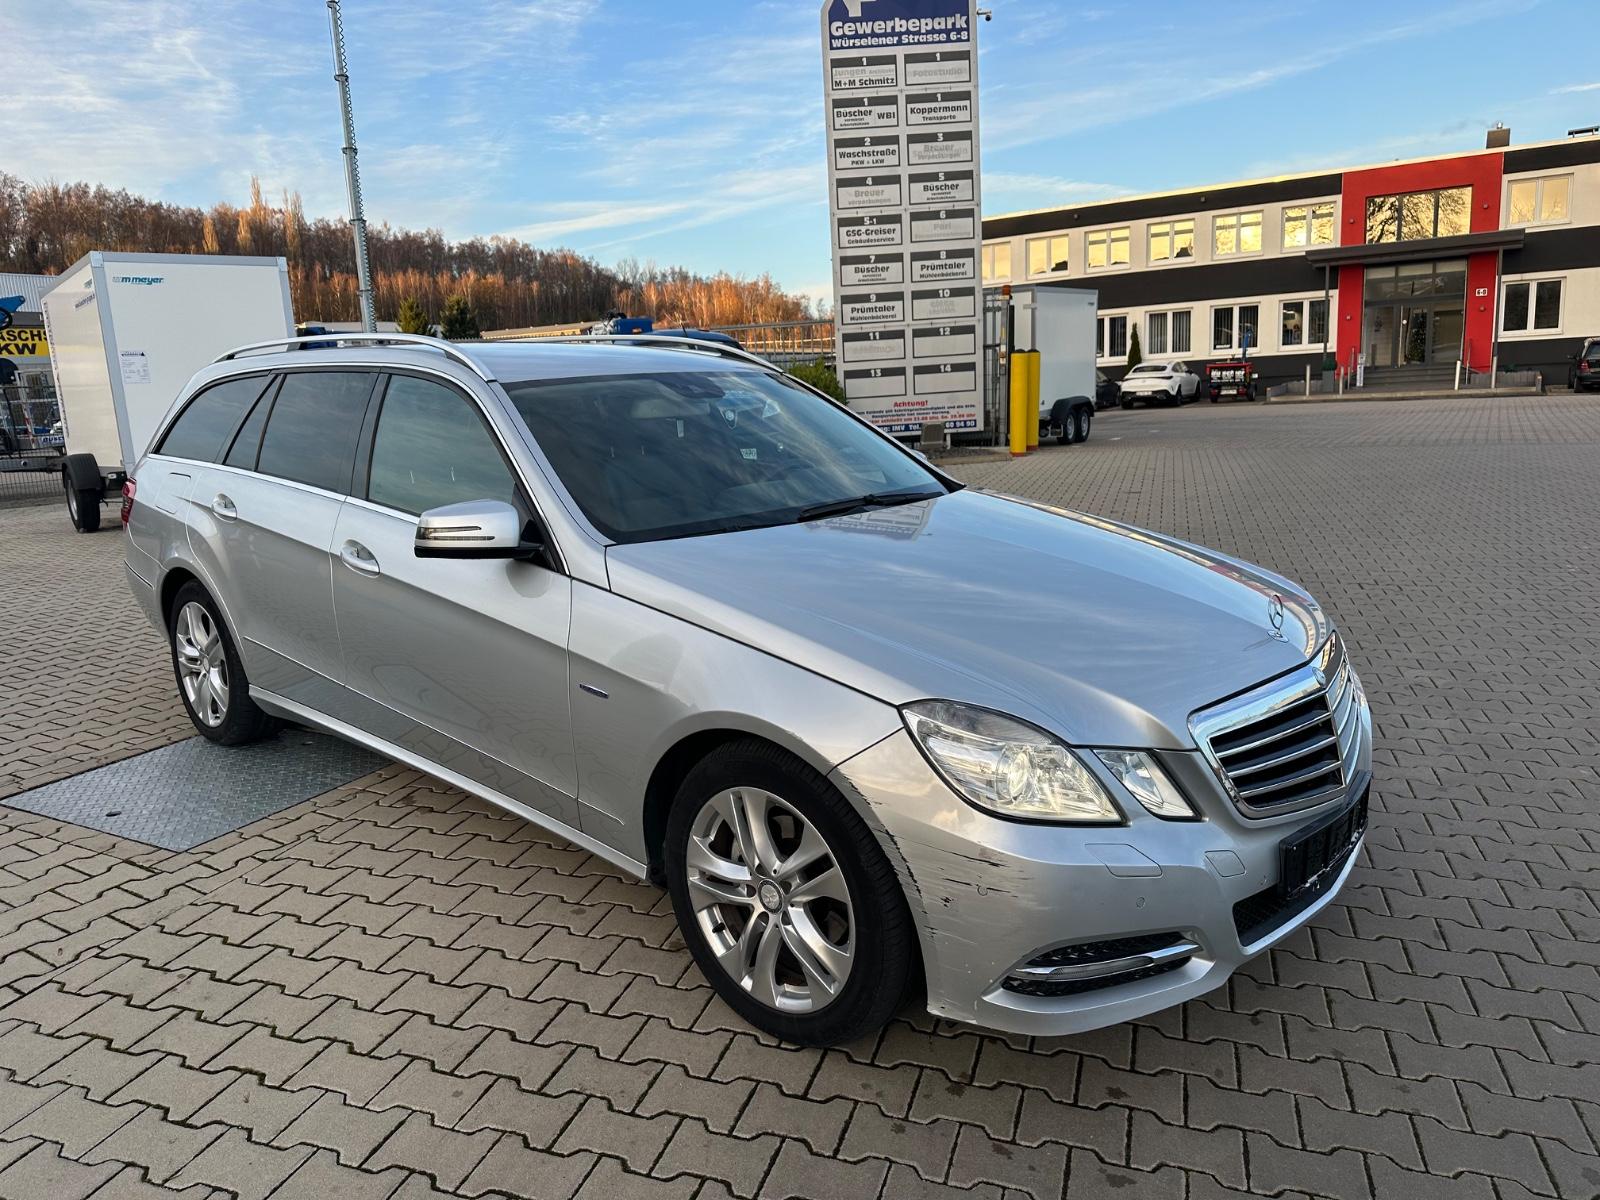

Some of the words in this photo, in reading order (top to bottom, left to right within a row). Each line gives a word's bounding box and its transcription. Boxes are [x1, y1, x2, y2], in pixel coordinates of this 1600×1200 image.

[831, 14, 967, 36] Gewerbepark
[832, 36, 898, 47] Würselener
[902, 34, 946, 44] Strasse
[950, 32, 968, 40] 6-8
[936, 53, 940, 61] 1
[864, 98, 868, 106] 1
[836, 109, 873, 117] Büscher
[910, 104, 968, 114] Koppermann
[937, 133, 943, 141] 3
[839, 149, 896, 159] Waschstraße
[923, 184, 959, 192] Büscher
[940, 211, 946, 219] 6
[864, 217, 877, 225] 5-1
[846, 227, 896, 237] GSG-Greiser
[940, 251, 946, 259] 8
[921, 262, 966, 271] Prümtaler
[131, 276, 165, 285] meyer
[870, 294, 876, 302] 9
[851, 305, 895, 314] Prümtaler
[869, 332, 879, 340] 11
[871, 369, 881, 377] 13
